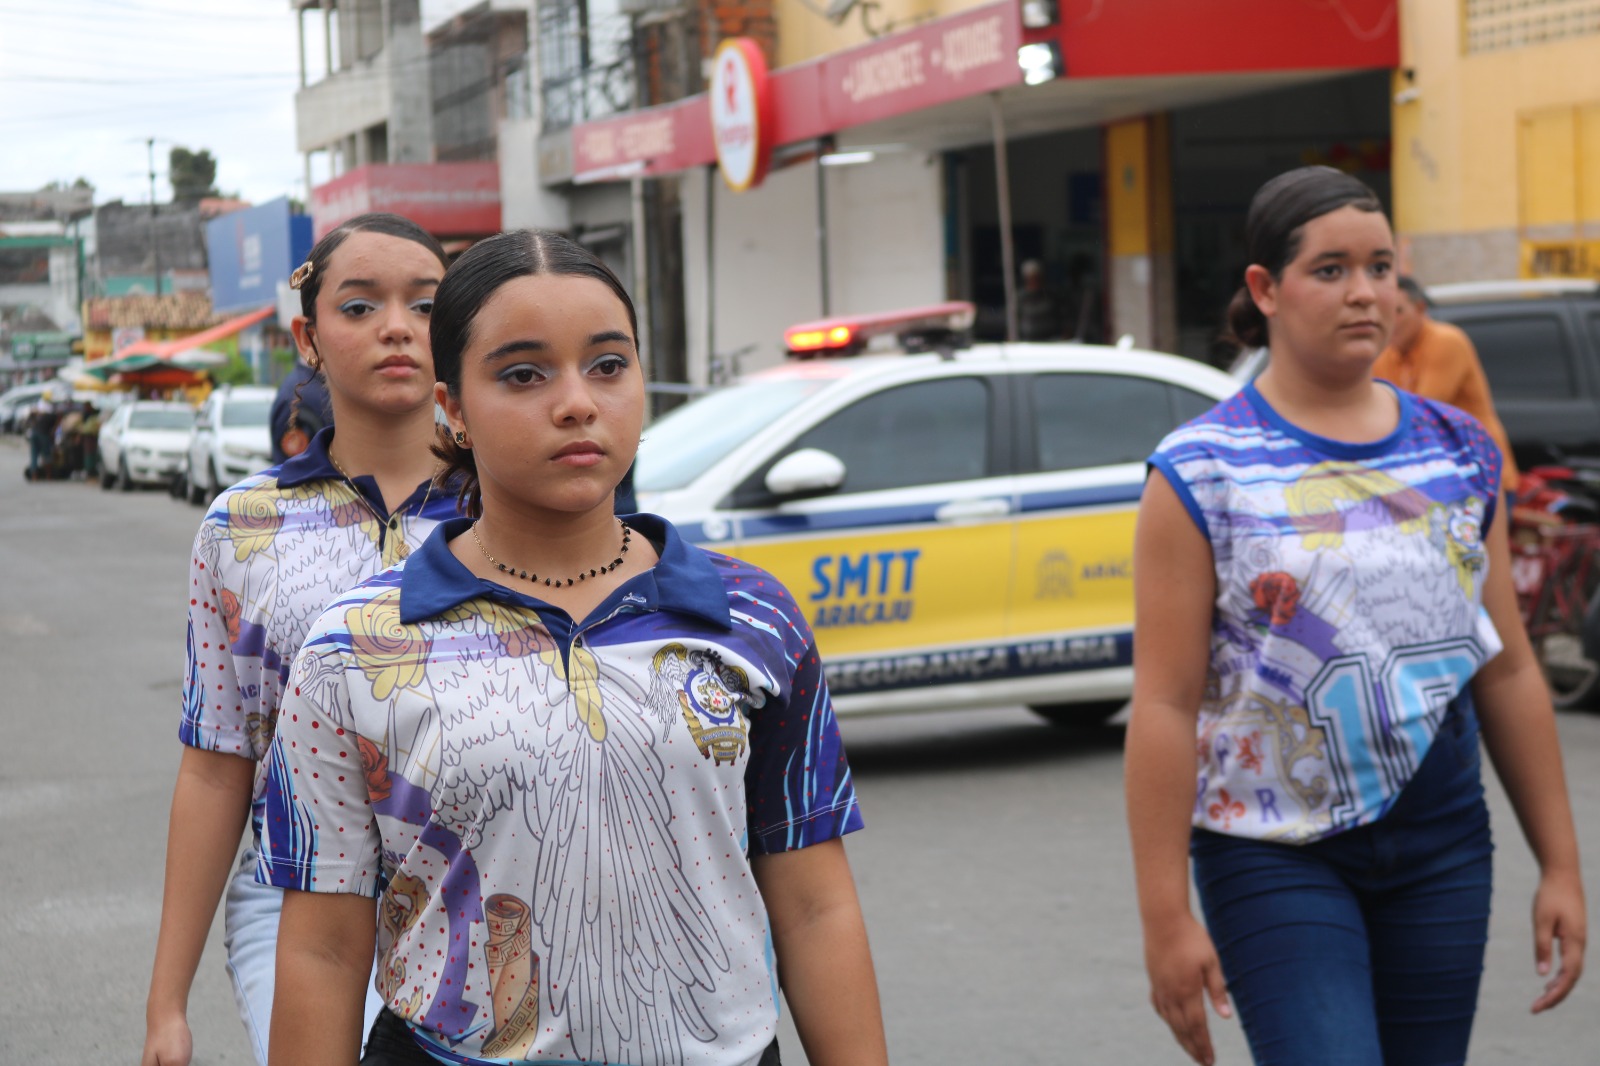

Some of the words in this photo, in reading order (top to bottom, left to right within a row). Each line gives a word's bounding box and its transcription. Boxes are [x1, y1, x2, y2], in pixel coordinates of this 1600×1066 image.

[810, 548, 920, 601] SMTT
[814, 599, 913, 628] ARACAJU
[825, 647, 1009, 692] SEGURANÇA
[1255, 787, 1283, 823] R
